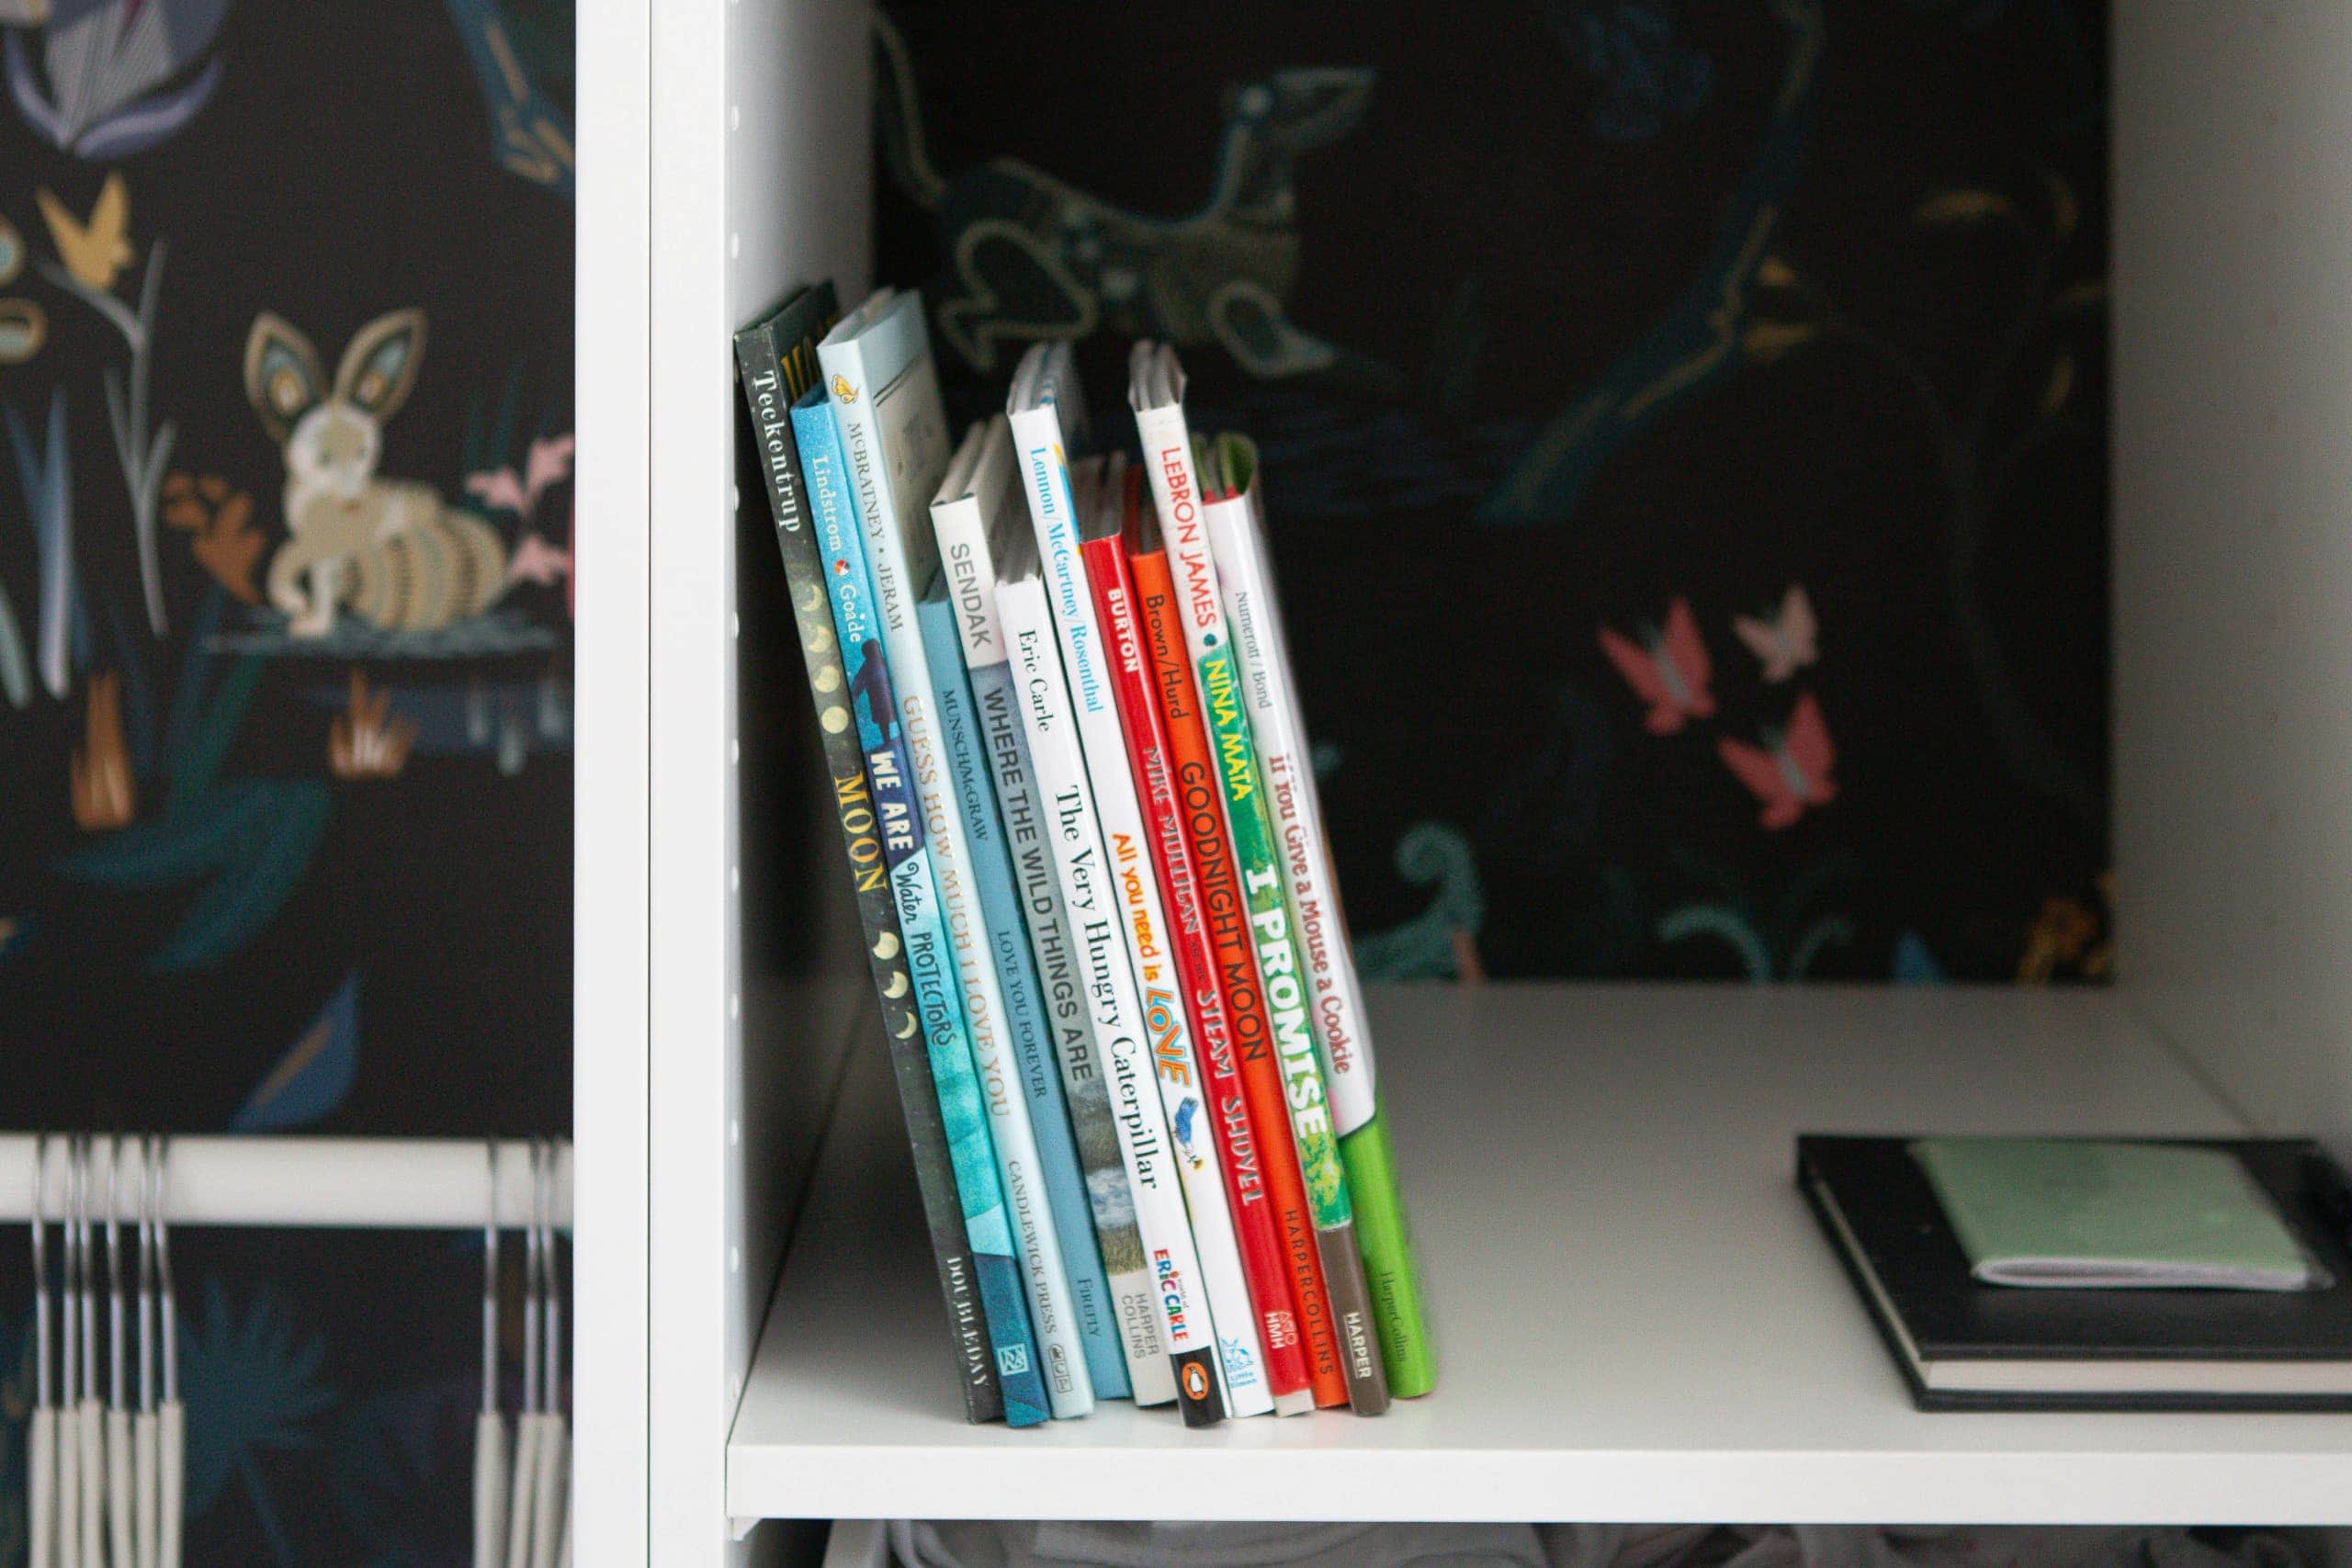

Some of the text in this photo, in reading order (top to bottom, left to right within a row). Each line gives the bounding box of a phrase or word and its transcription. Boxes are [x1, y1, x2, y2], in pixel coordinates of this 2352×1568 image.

[753, 369, 801, 533] Teckentrup
[812, 456, 842, 552] Lindstrom
[1161, 447, 1217, 627] LEBRON JAMES
[839, 584, 865, 643] Goade
[877, 562, 904, 632] JERAM
[950, 543, 992, 649] SENDAK
[1107, 589, 1140, 672] BURTON
[1019, 629, 1054, 733] Eric Carle
[1205, 659, 1252, 801] NINA MATA
[1252, 671, 1273, 709] Bond
[834, 771, 888, 892] MOON
[870, 751, 913, 853] WE ARE
[1144, 747, 1171, 806] MIKE
[1159, 814, 1200, 935] MULLIGAN
[1284, 825, 1308, 876] Give
[896, 862, 920, 924] Water
[903, 696, 937, 789] GUESS
[924, 794, 956, 860] HOW
[941, 869, 974, 950] MUCH
[963, 977, 993, 1053] LOVE
[981, 1056, 1010, 1117] YOU
[984, 688, 1093, 1081] WHERE THE WILD THINGS ARE
[1181, 761, 1268, 1062] GOODNIGHT MOON
[1296, 881, 1313, 896] a
[1057, 784, 1159, 1190] The Very Hungry Caterpillar
[1113, 832, 1191, 1089] All you need is LOVE
[1299, 899, 1329, 975] Mouse
[1316, 978, 1332, 993] a
[998, 931, 1046, 1100] LOVE YOU FOREVER
[1246, 864, 1328, 1139] I PROMISE
[1320, 996, 1353, 1074] Cookie
[1197, 989, 1264, 1206] STEAM SHOVEL
[1009, 1161, 1056, 1335] CANDLEWICK PRESS
[1154, 1248, 1178, 1292] ERIC
[1284, 1210, 1334, 1375] HARPERCOLLINS
[1122, 1295, 1147, 1359] COLLINS
[1135, 1293, 1159, 1355] HARPER
[1164, 1294, 1189, 1341] CARLE
[1264, 1313, 1286, 1348] HMH
[1345, 1312, 1373, 1378] HARPER
